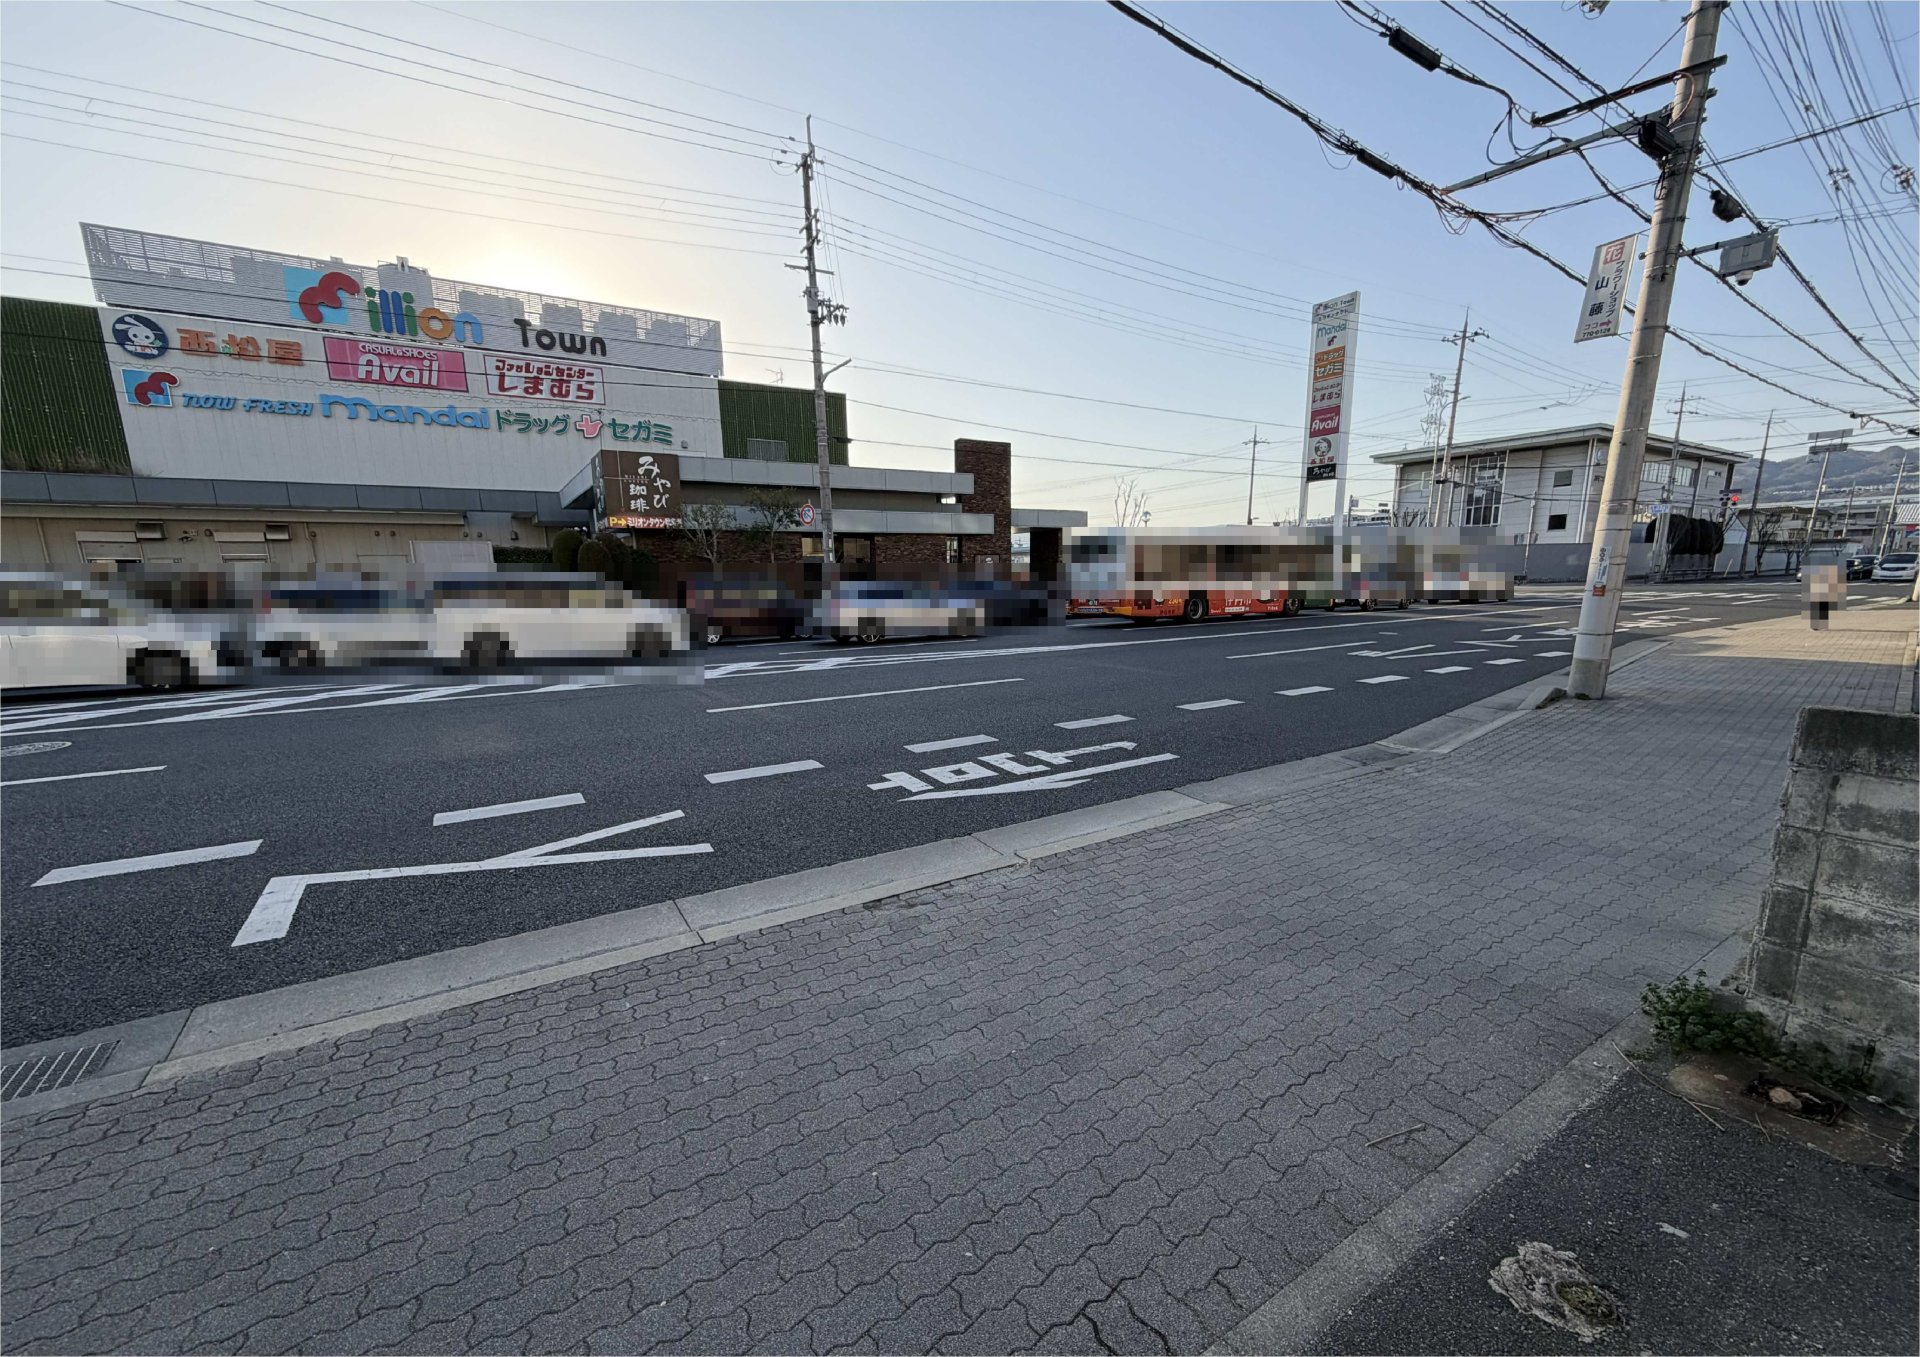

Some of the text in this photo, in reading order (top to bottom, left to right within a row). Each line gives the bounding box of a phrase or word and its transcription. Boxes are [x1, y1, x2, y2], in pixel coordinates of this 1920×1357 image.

[1604, 242, 1625, 264] 花
[1606, 260, 1625, 317] フラワーショップ
[177, 328, 305, 367] 西松屋
[513, 317, 607, 358] Town
[357, 354, 439, 387] Avail
[495, 358, 594, 379] ファッションセンター
[1315, 362, 1344, 377] セガミ
[497, 373, 595, 401] しまむら
[319, 394, 491, 430] mandai
[496, 409, 674, 446] ドラッグ セガミ
[1312, 416, 1339, 431] Avail
[637, 455, 672, 509] みやび
